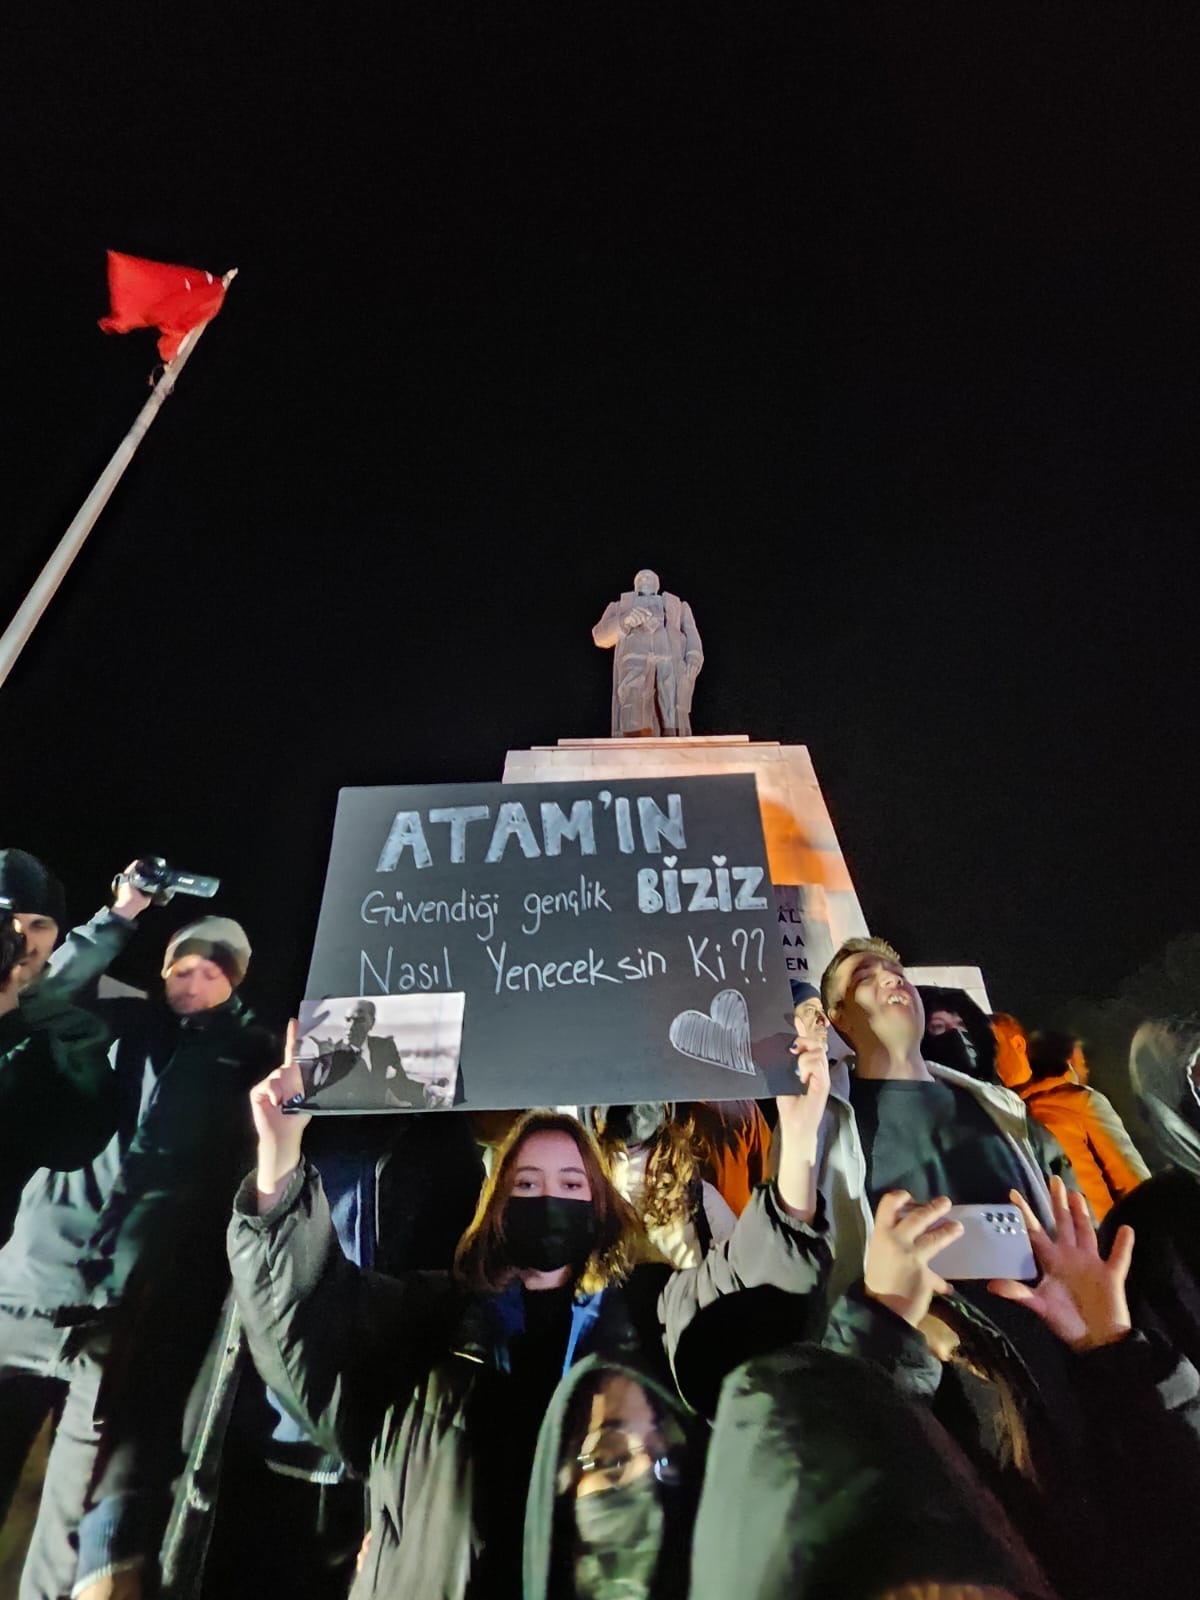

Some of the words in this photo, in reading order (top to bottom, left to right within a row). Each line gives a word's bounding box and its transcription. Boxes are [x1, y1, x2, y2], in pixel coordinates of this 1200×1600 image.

[375, 789, 687, 873] ATAM'IN
[360, 888, 500, 942] Güvendiği
[521, 873, 613, 935] gençlik
[636, 855, 769, 914] BİZİZ
[359, 946, 454, 996] Nasıl
